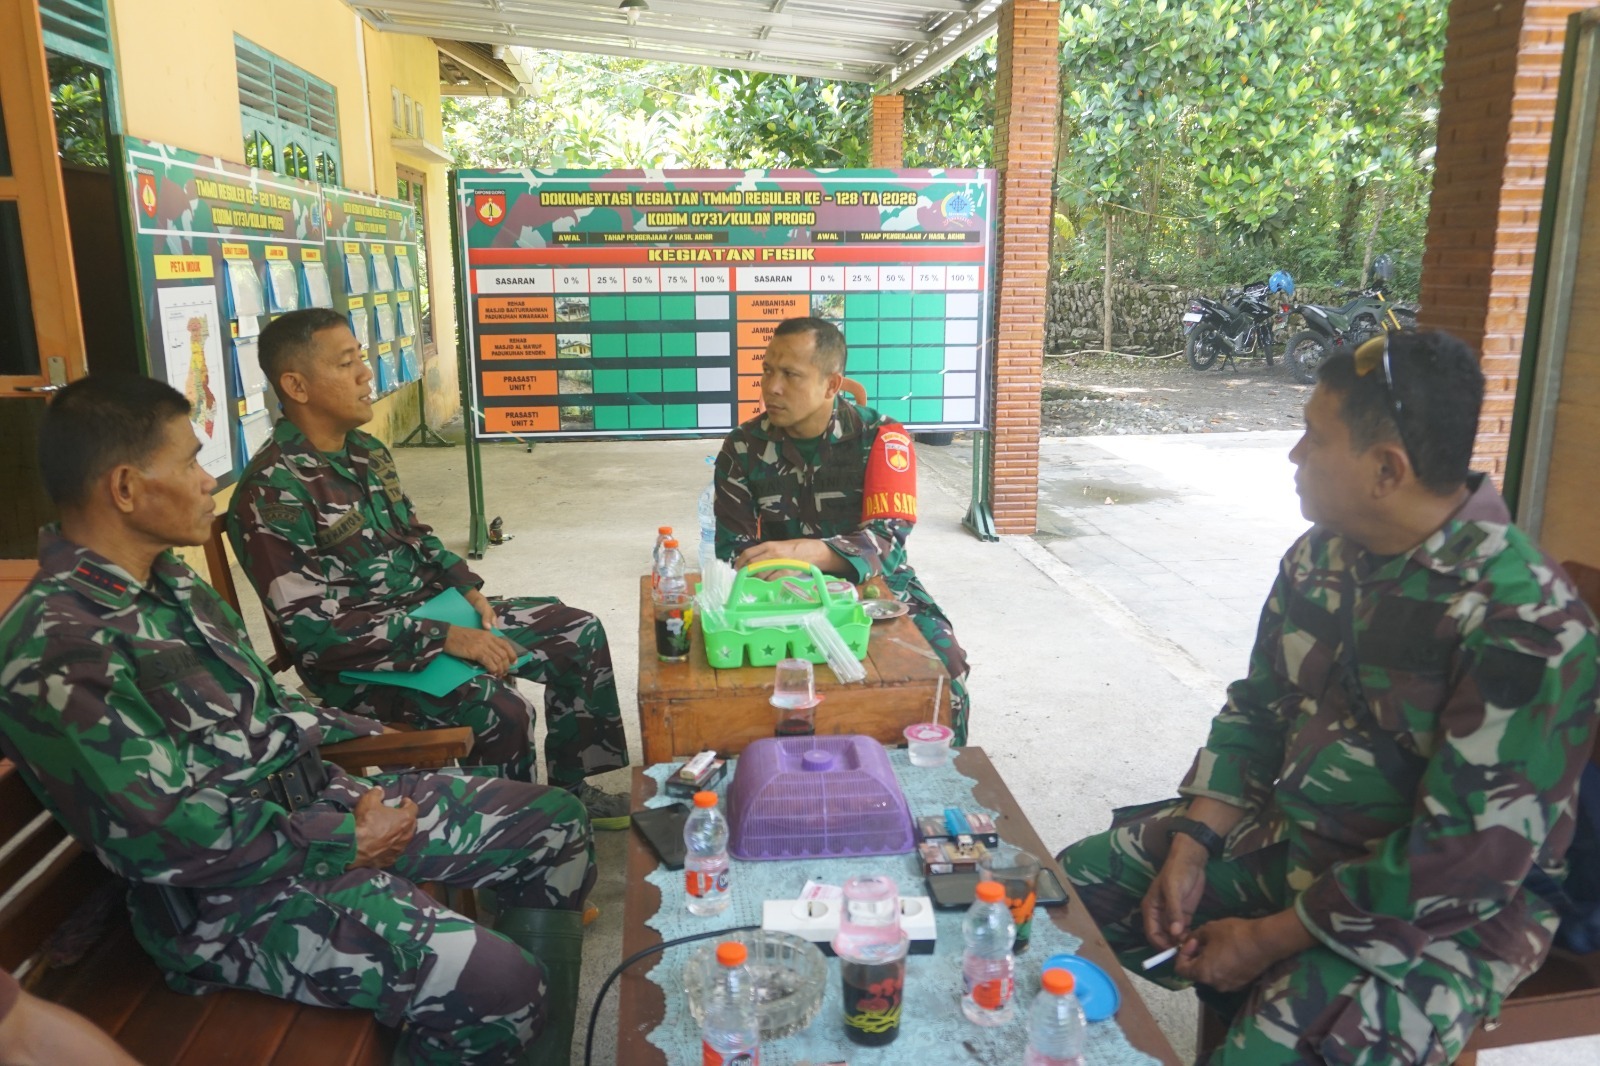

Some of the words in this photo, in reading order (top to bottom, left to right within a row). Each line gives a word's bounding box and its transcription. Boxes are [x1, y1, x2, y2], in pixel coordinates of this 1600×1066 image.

[540, 192, 633, 206] DOKUMENTASI
[635, 192, 699, 206] KEGIATAN
[702, 191, 742, 205] TMMD
[745, 191, 801, 205] REGULER
[804, 191, 821, 205] KE
[835, 191, 859, 205] 128
[861, 191, 880, 205] TA
[882, 191, 917, 206] 2026
[647, 212, 688, 226] KODIM
[691, 212, 771, 226] 0731/KULON
[774, 212, 816, 226] PROGO
[648, 248, 755, 262] KEGIATAN
[762, 248, 815, 261] FISIK
[170, 261, 185, 272] PETA
[866, 492, 889, 516] DAN
